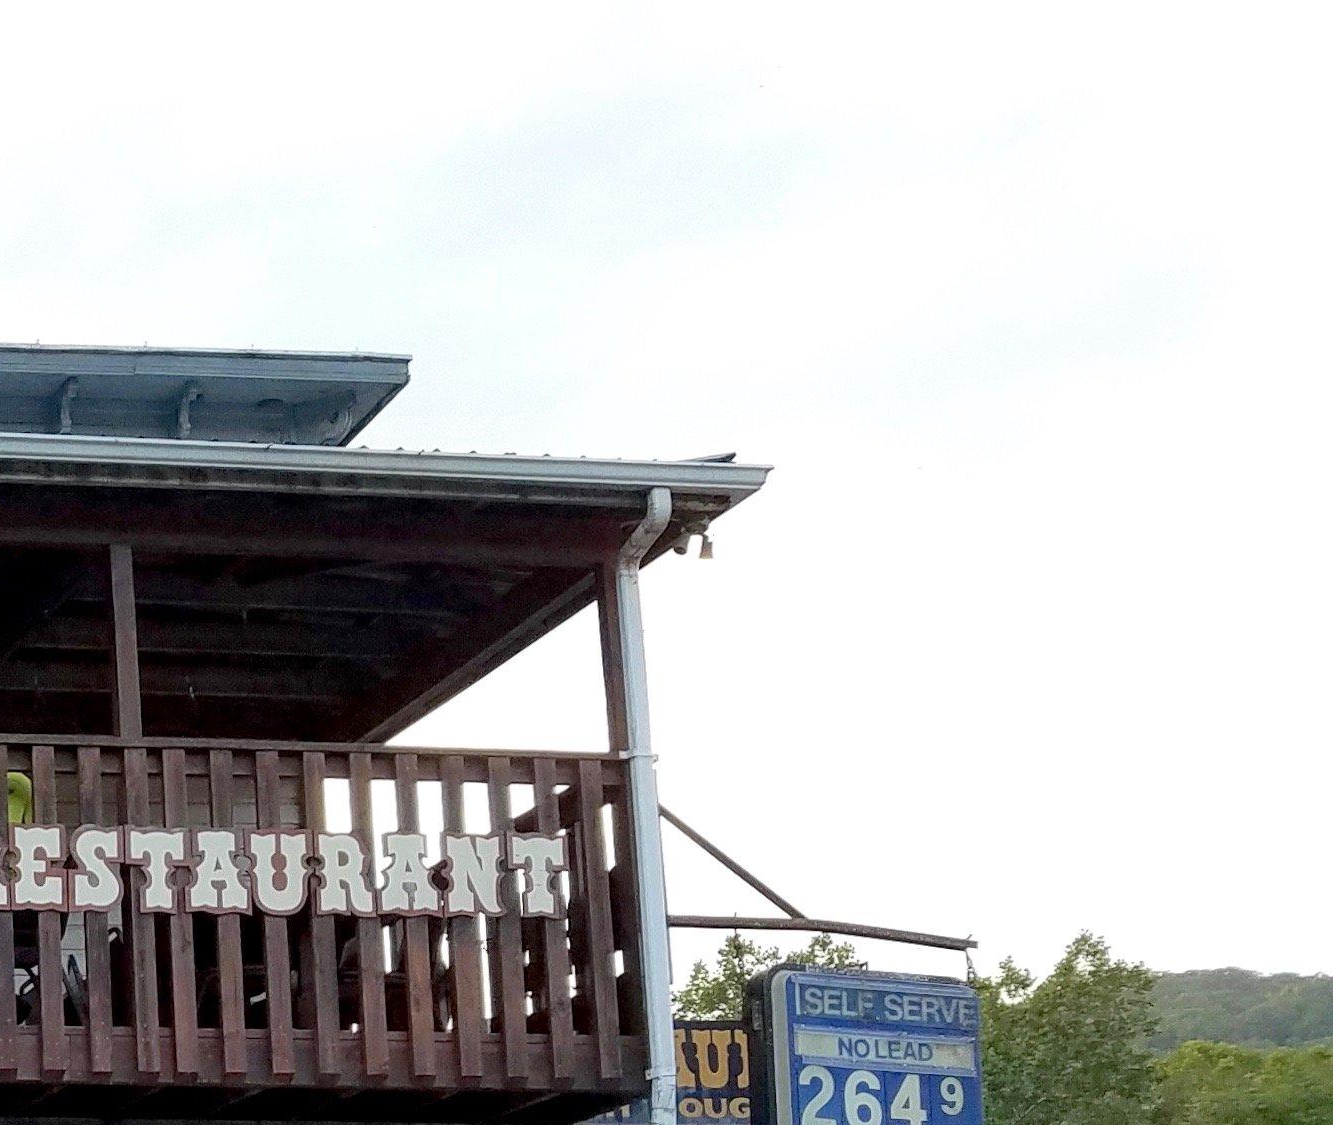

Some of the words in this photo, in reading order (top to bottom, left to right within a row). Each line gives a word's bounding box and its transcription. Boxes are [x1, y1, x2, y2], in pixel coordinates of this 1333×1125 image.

[804, 986, 873, 1019] SELF
[884, 997, 978, 1027] SERVE
[838, 1037, 870, 1057] NO
[874, 1038, 933, 1062] LEAD
